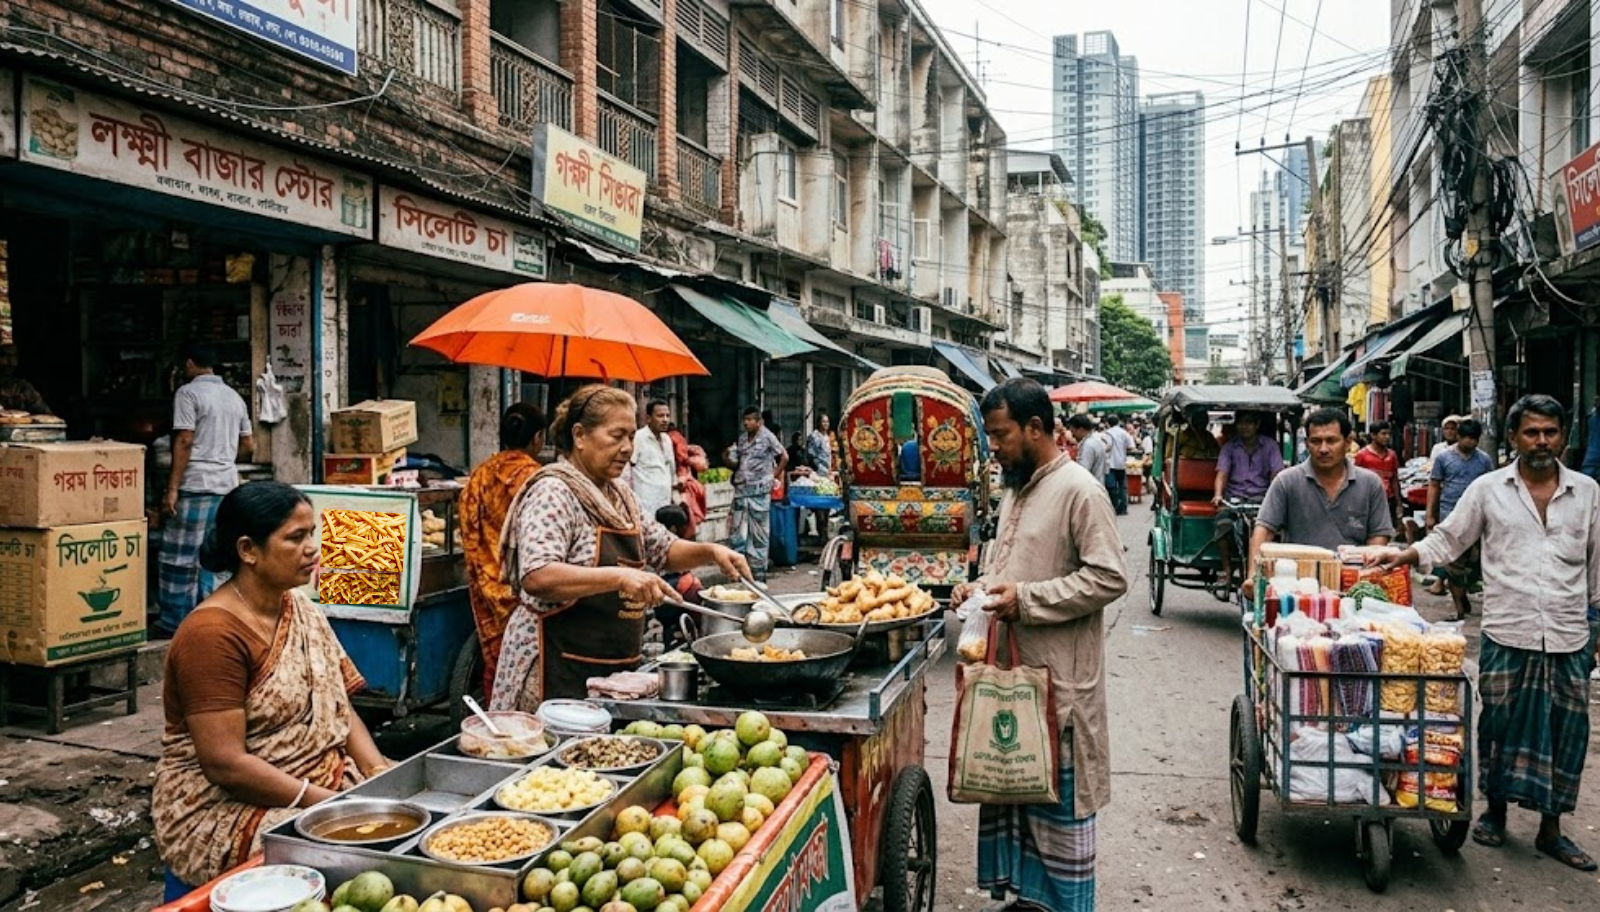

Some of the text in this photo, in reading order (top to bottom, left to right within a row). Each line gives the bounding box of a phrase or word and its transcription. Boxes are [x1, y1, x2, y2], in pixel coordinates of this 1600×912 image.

[180, 137, 266, 193] বাজার
[275, 157, 335, 211] স্টোর
[1567, 147, 1600, 213] সিলে
[392, 194, 478, 246] সিলেটি
[485, 226, 508, 257] চা
[54, 470, 87, 492] গরম
[56, 529, 141, 568] সিলেটি চা
